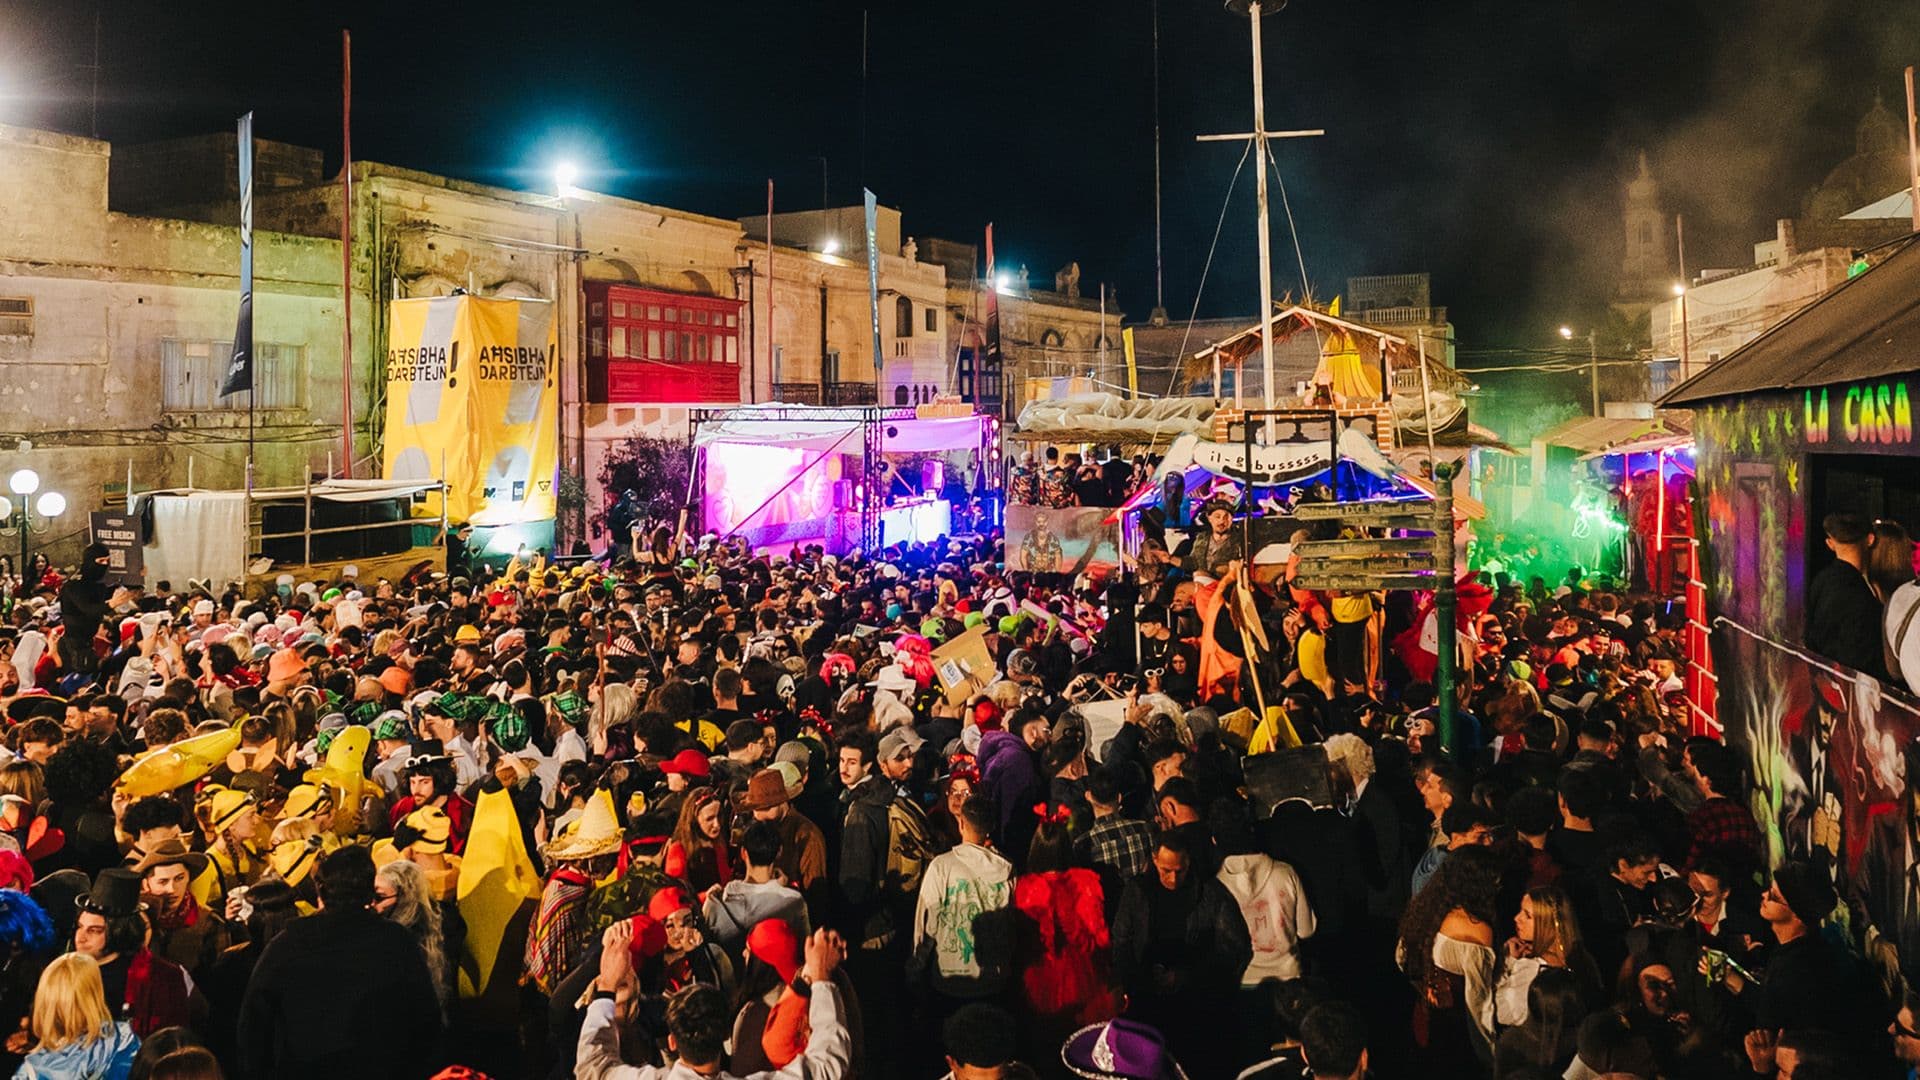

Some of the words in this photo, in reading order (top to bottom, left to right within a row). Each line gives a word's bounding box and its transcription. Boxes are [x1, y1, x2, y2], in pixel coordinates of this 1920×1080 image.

[387, 365, 447, 382] DARBTEJN
[479, 364, 546, 381] DARBTEJN
[1805, 388, 1829, 444] LA
[1844, 382, 1912, 445] CASA
[97, 529, 113, 539] FREE
[113, 530, 136, 540] MERCH
